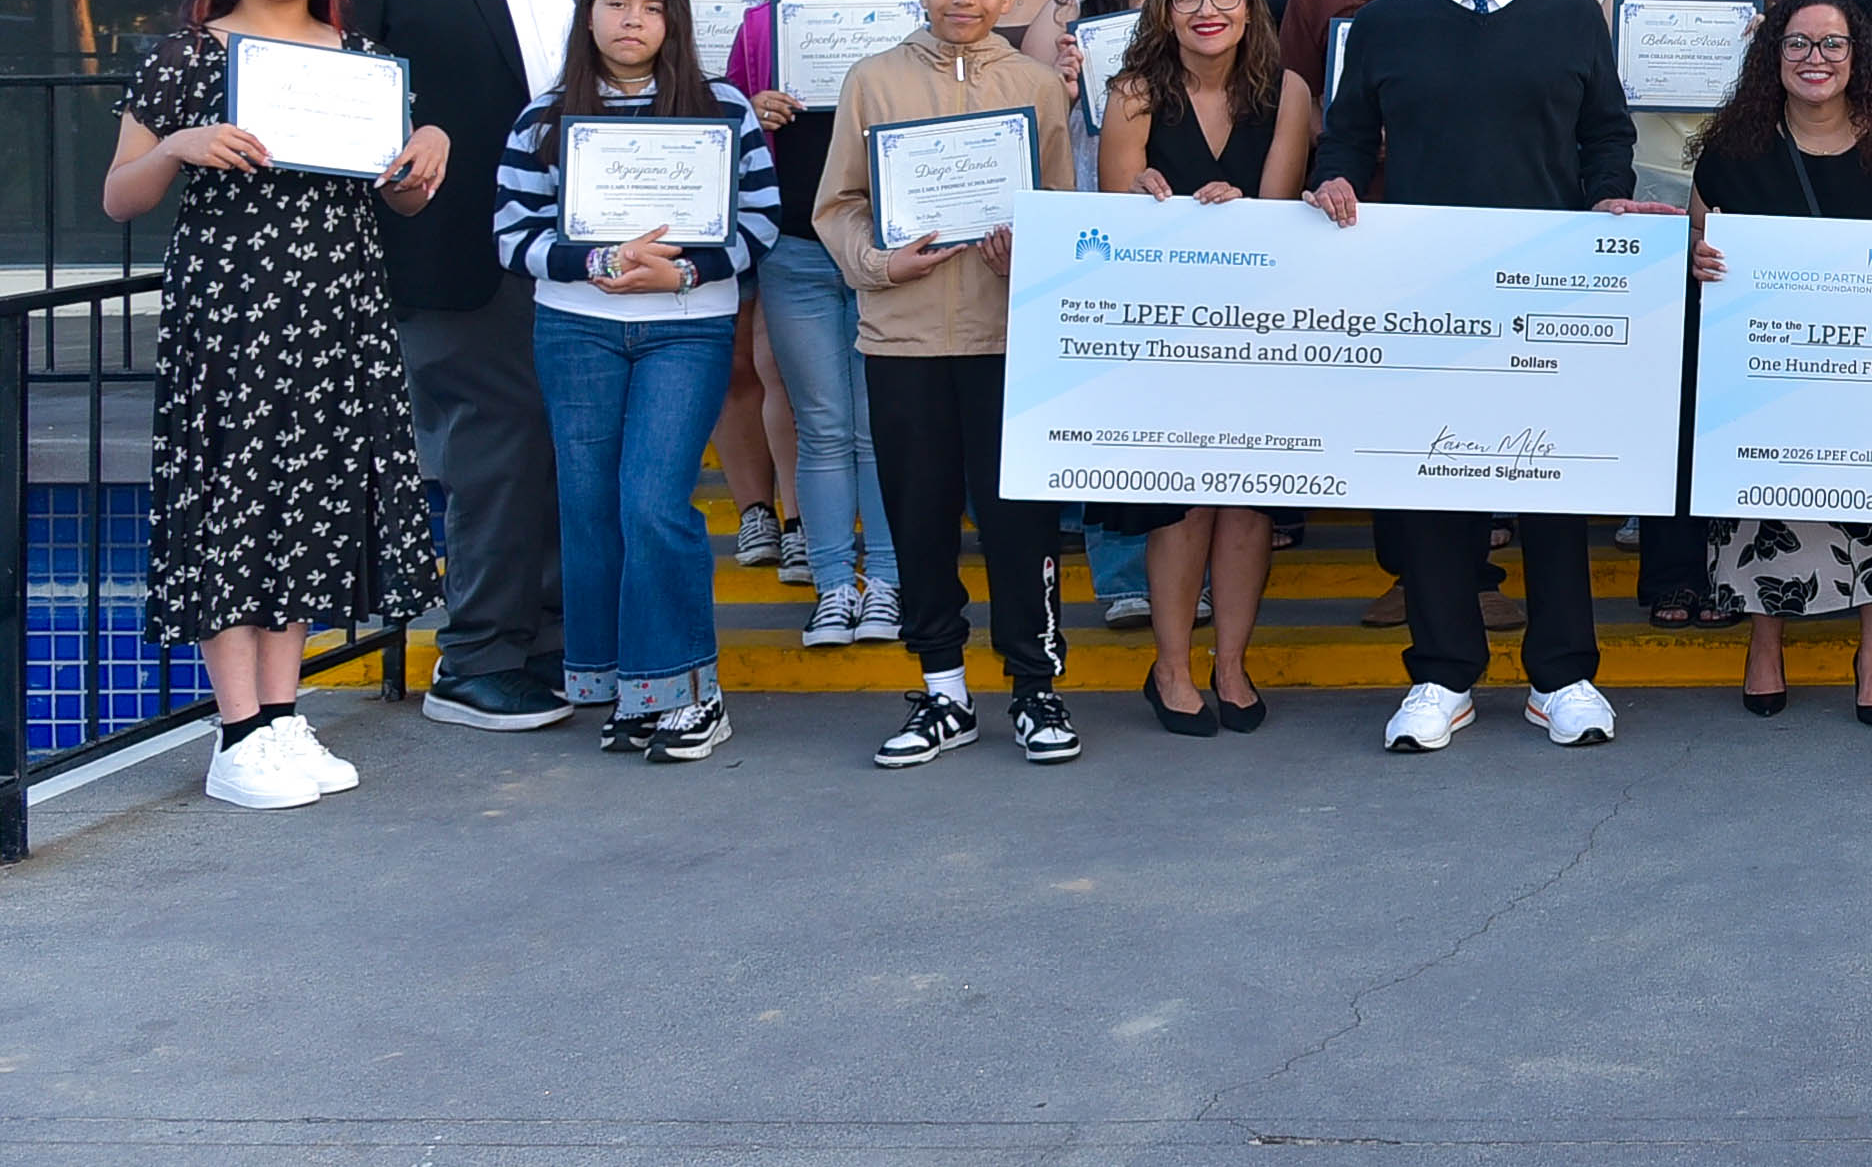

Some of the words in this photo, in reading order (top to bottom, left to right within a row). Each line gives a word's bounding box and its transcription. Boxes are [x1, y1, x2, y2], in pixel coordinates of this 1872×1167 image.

[800, 32, 848, 49] Jocelyn
[1641, 33, 1687, 46] Belinda
[1690, 35, 1731, 46] Acosta
[915, 163, 952, 181] Diego
[1594, 238, 1640, 255] 1236
[1114, 248, 1163, 263] KAISER
[1496, 271, 1530, 286] Date
[1534, 274, 1567, 289] June
[1571, 275, 1593, 290] 12,
[1596, 276, 1627, 289] 2026
[1753, 269, 1819, 282] LYNWOOD
[1755, 282, 1814, 291] EDUCATIONAL
[1817, 285, 1872, 294] FOUNDATION
[1061, 300, 1081, 312] Pay
[1085, 301, 1095, 309] to
[1100, 301, 1116, 310] the
[1060, 313, 1089, 323] Order
[1092, 314, 1103, 323] of
[1122, 304, 1185, 326] LPEF
[1191, 307, 1285, 333] College
[1293, 310, 1376, 337] Pledge
[1383, 313, 1492, 335] Scholars
[1749, 320, 1770, 332] Pay
[1773, 322, 1783, 330] to
[1787, 321, 1802, 330] the
[1512, 316, 1524, 335] $
[1536, 322, 1614, 339] 20,000.00
[1807, 324, 1866, 346] LPEF
[1749, 333, 1776, 343] Order
[1779, 334, 1789, 343] of
[1060, 338, 1139, 361] Twenty
[1146, 340, 1252, 362] Thousand
[1258, 343, 1298, 362] and
[1304, 345, 1383, 364] 00/100
[1510, 356, 1558, 369] Dollars
[1748, 357, 1780, 372] One
[1785, 358, 1857, 375] Hundred
[1049, 430, 1092, 442] MEMO
[1096, 430, 1129, 442] 2026
[1132, 431, 1162, 443] LPEF
[1167, 431, 1215, 447] College
[1218, 433, 1261, 448] Pledge
[1265, 435, 1322, 450] Program
[1737, 448, 1778, 459] MEMO
[1782, 448, 1813, 460] 2026
[1817, 448, 1846, 461] LPEF
[1418, 464, 1490, 479] Authorized
[1495, 466, 1561, 483] Signature
[1201, 473, 1347, 497] 9876590262c
